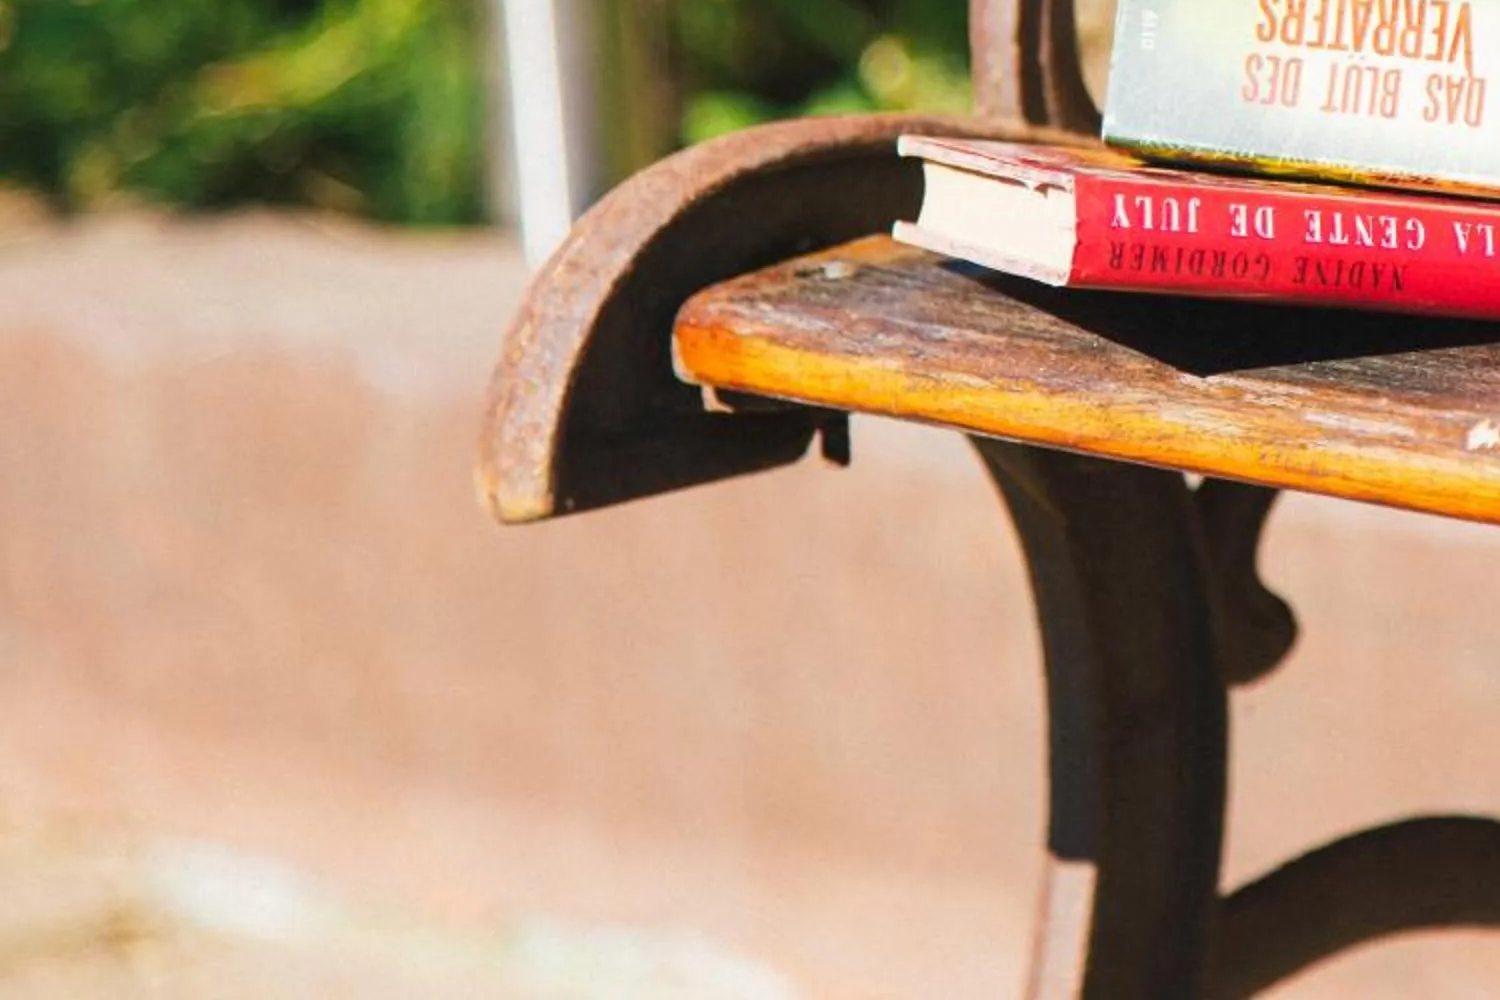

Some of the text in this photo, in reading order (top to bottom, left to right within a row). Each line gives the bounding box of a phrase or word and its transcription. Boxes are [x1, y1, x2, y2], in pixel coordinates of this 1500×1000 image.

[1241, 53, 1487, 127] DAS BLUT DES
[1111, 192, 1496, 257] LA GENTE DE JULY
[1108, 241, 1409, 291] NADINE GORDIMER
